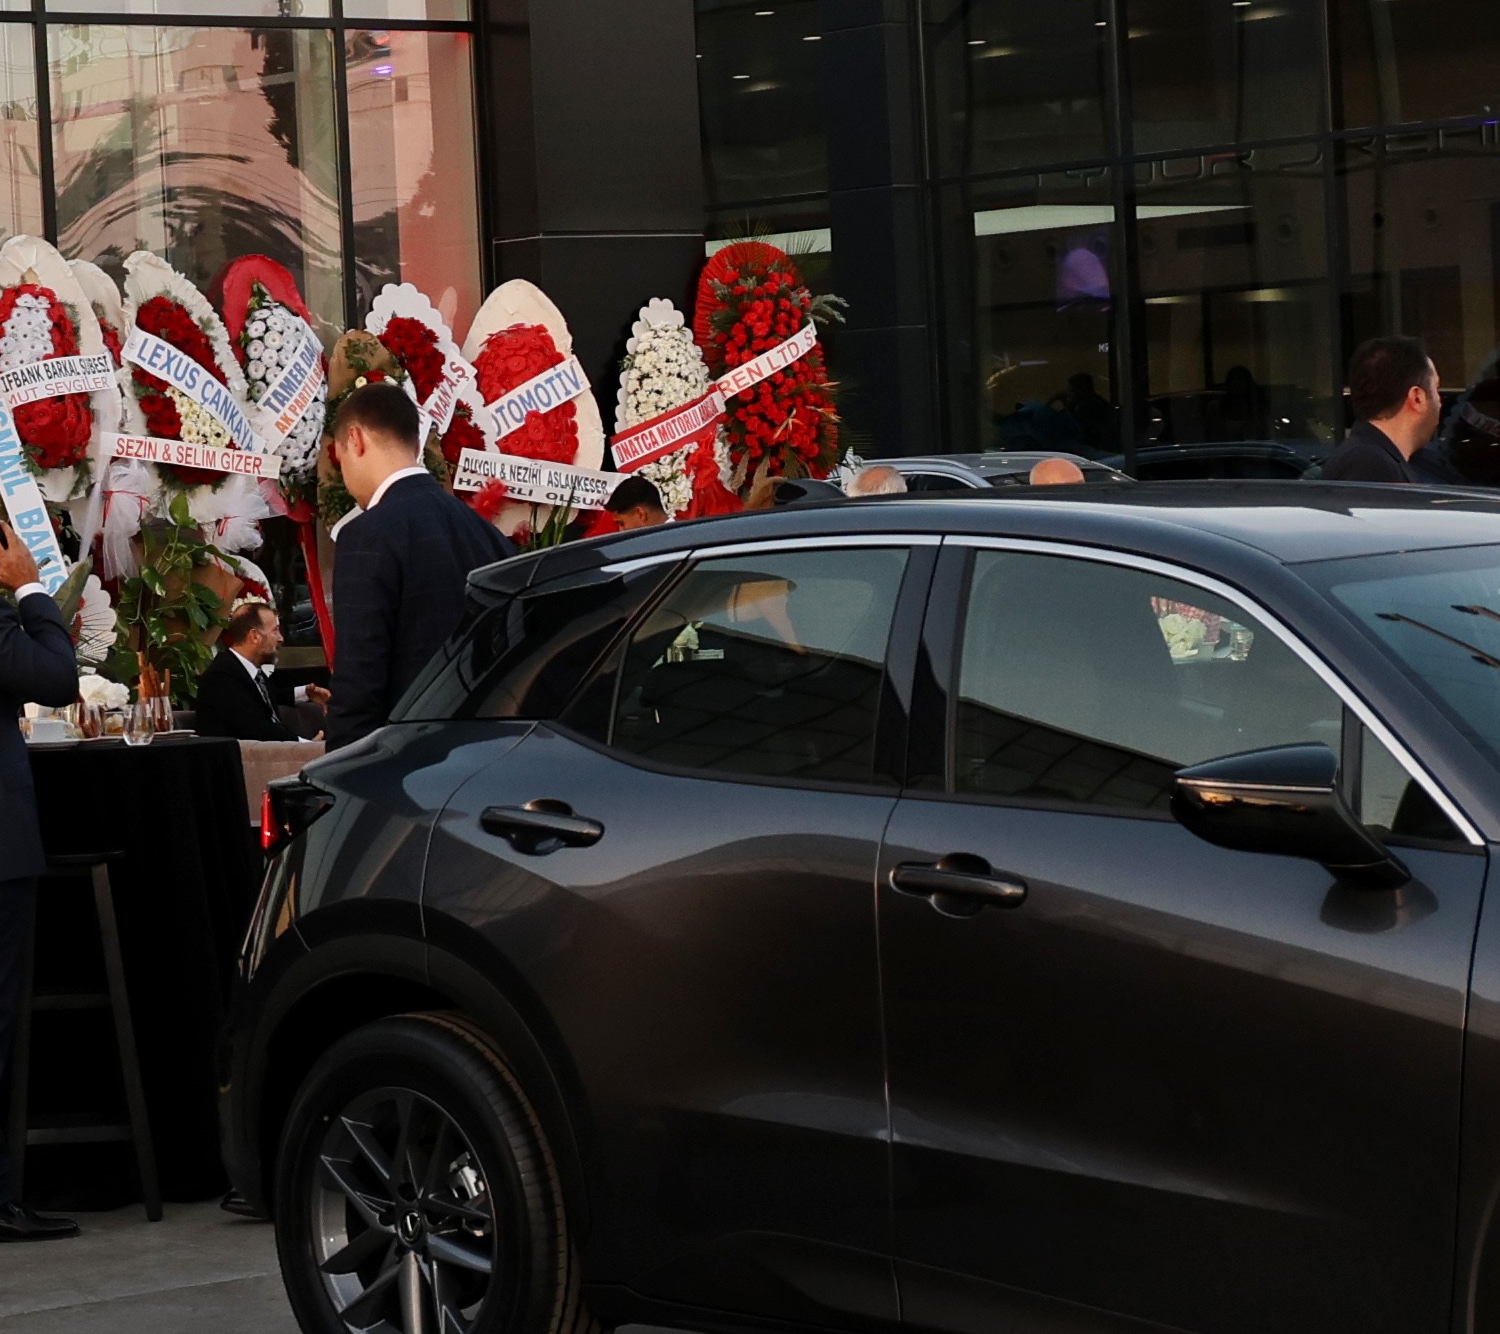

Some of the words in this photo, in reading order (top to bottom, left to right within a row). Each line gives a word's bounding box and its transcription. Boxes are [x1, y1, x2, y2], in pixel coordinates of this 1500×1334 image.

[137, 338, 200, 390] LEXUS
[200, 378, 255, 453] ÇANKAYA
[262, 360, 308, 415] TAMER
[274, 412, 295, 435] AK
[161, 443, 172, 463] &
[176, 443, 218, 468] SELİM
[220, 448, 262, 476] GİZER
[462, 456, 497, 478] DUYGU
[499, 463, 507, 480] &
[545, 492, 606, 507] OLSUN
